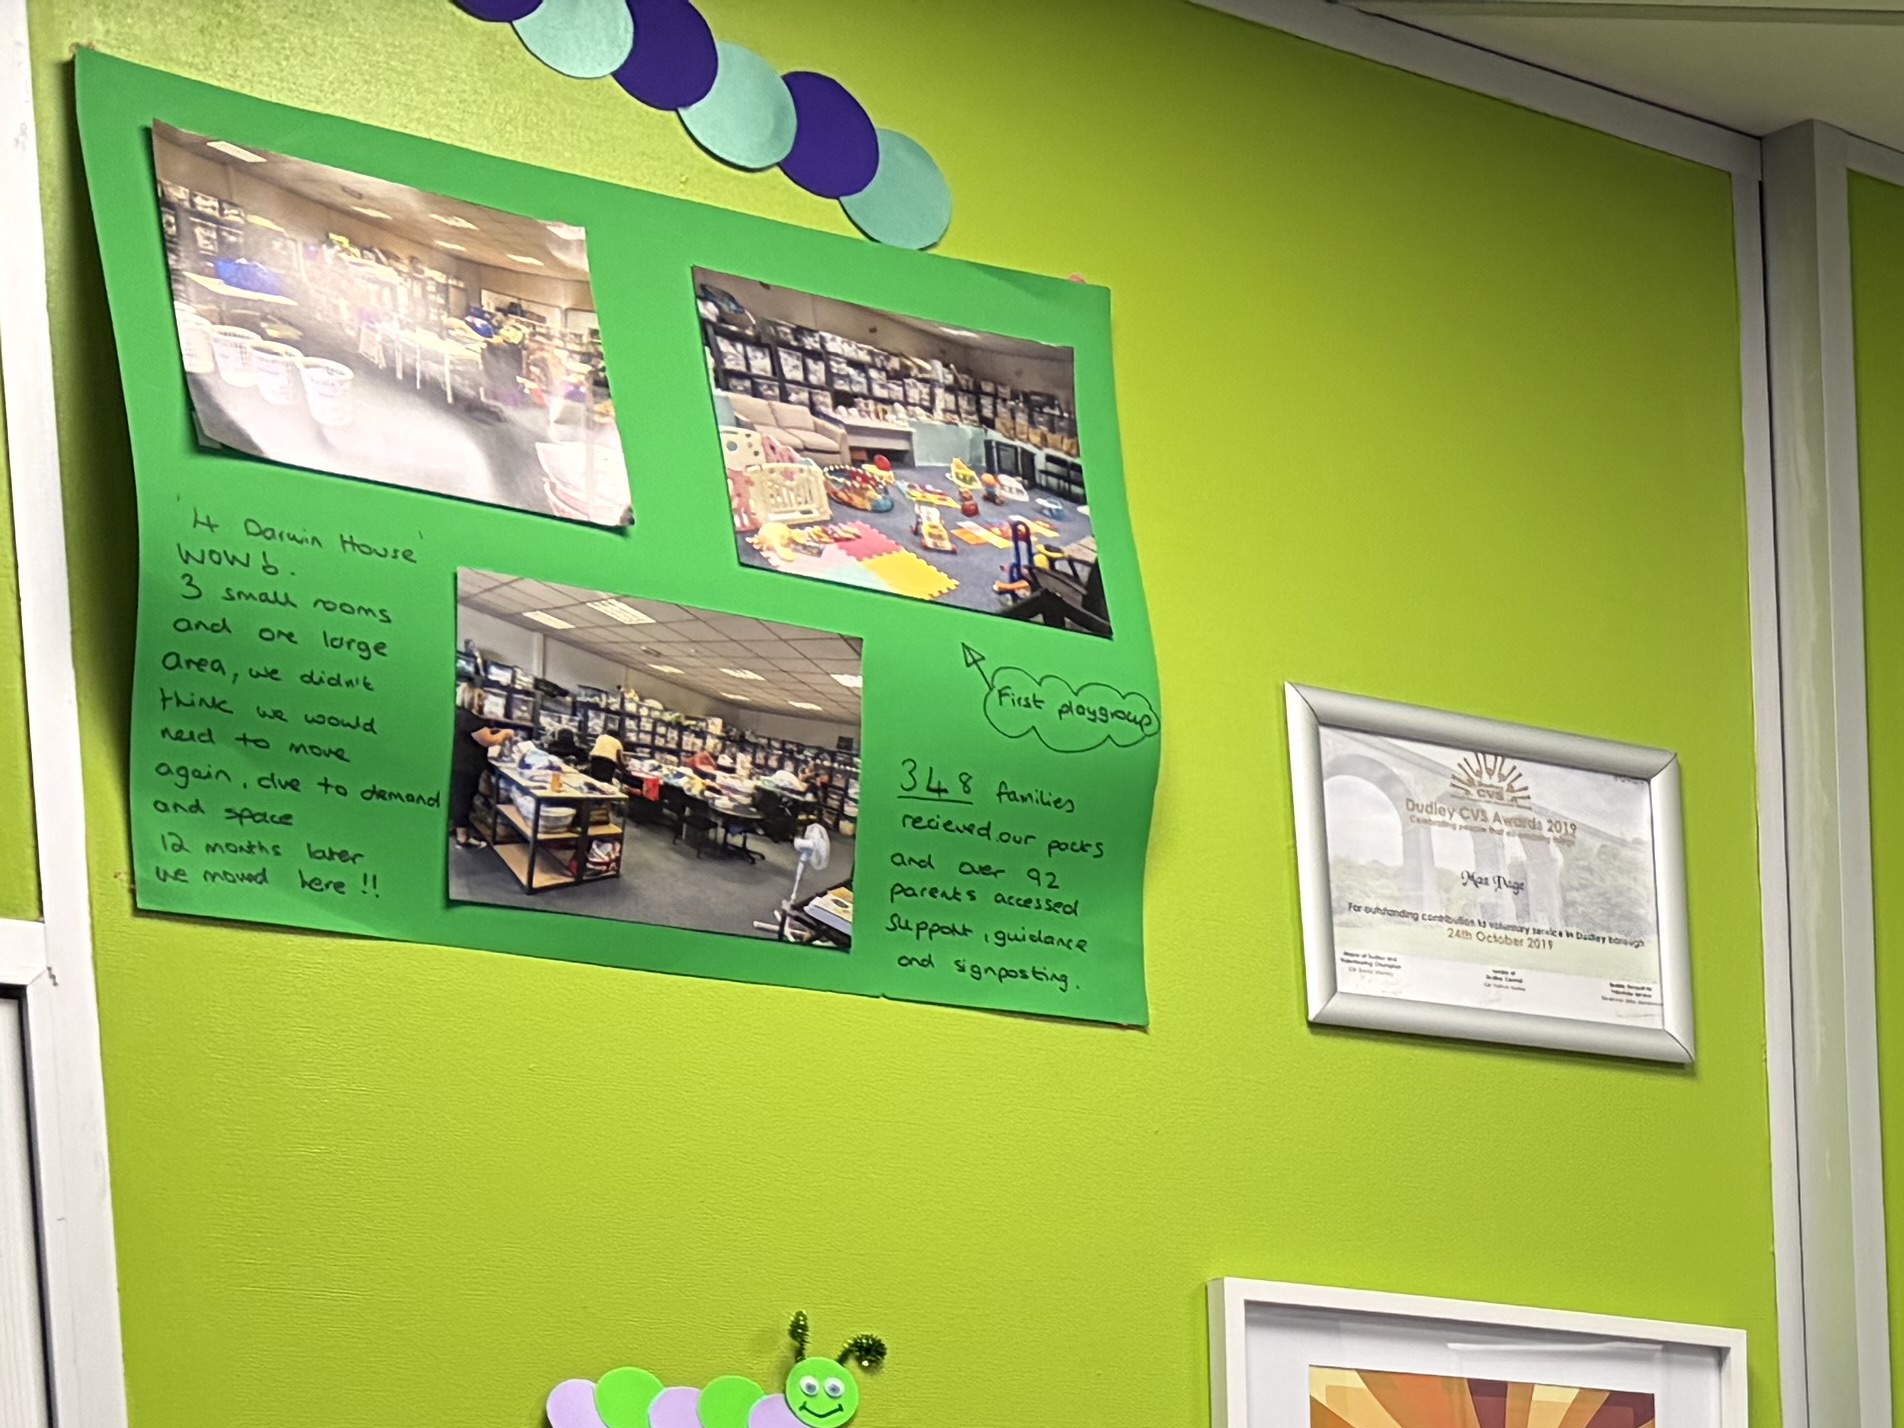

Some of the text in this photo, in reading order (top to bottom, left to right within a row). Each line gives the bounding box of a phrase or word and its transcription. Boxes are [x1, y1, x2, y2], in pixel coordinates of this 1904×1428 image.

[181, 574, 393, 624] 3 small rooms
[996, 688, 1154, 730] First playgroup
[899, 759, 1076, 813] 348 families
[161, 834, 192, 854] 12
[205, 840, 283, 858] months
[299, 870, 346, 896] here
